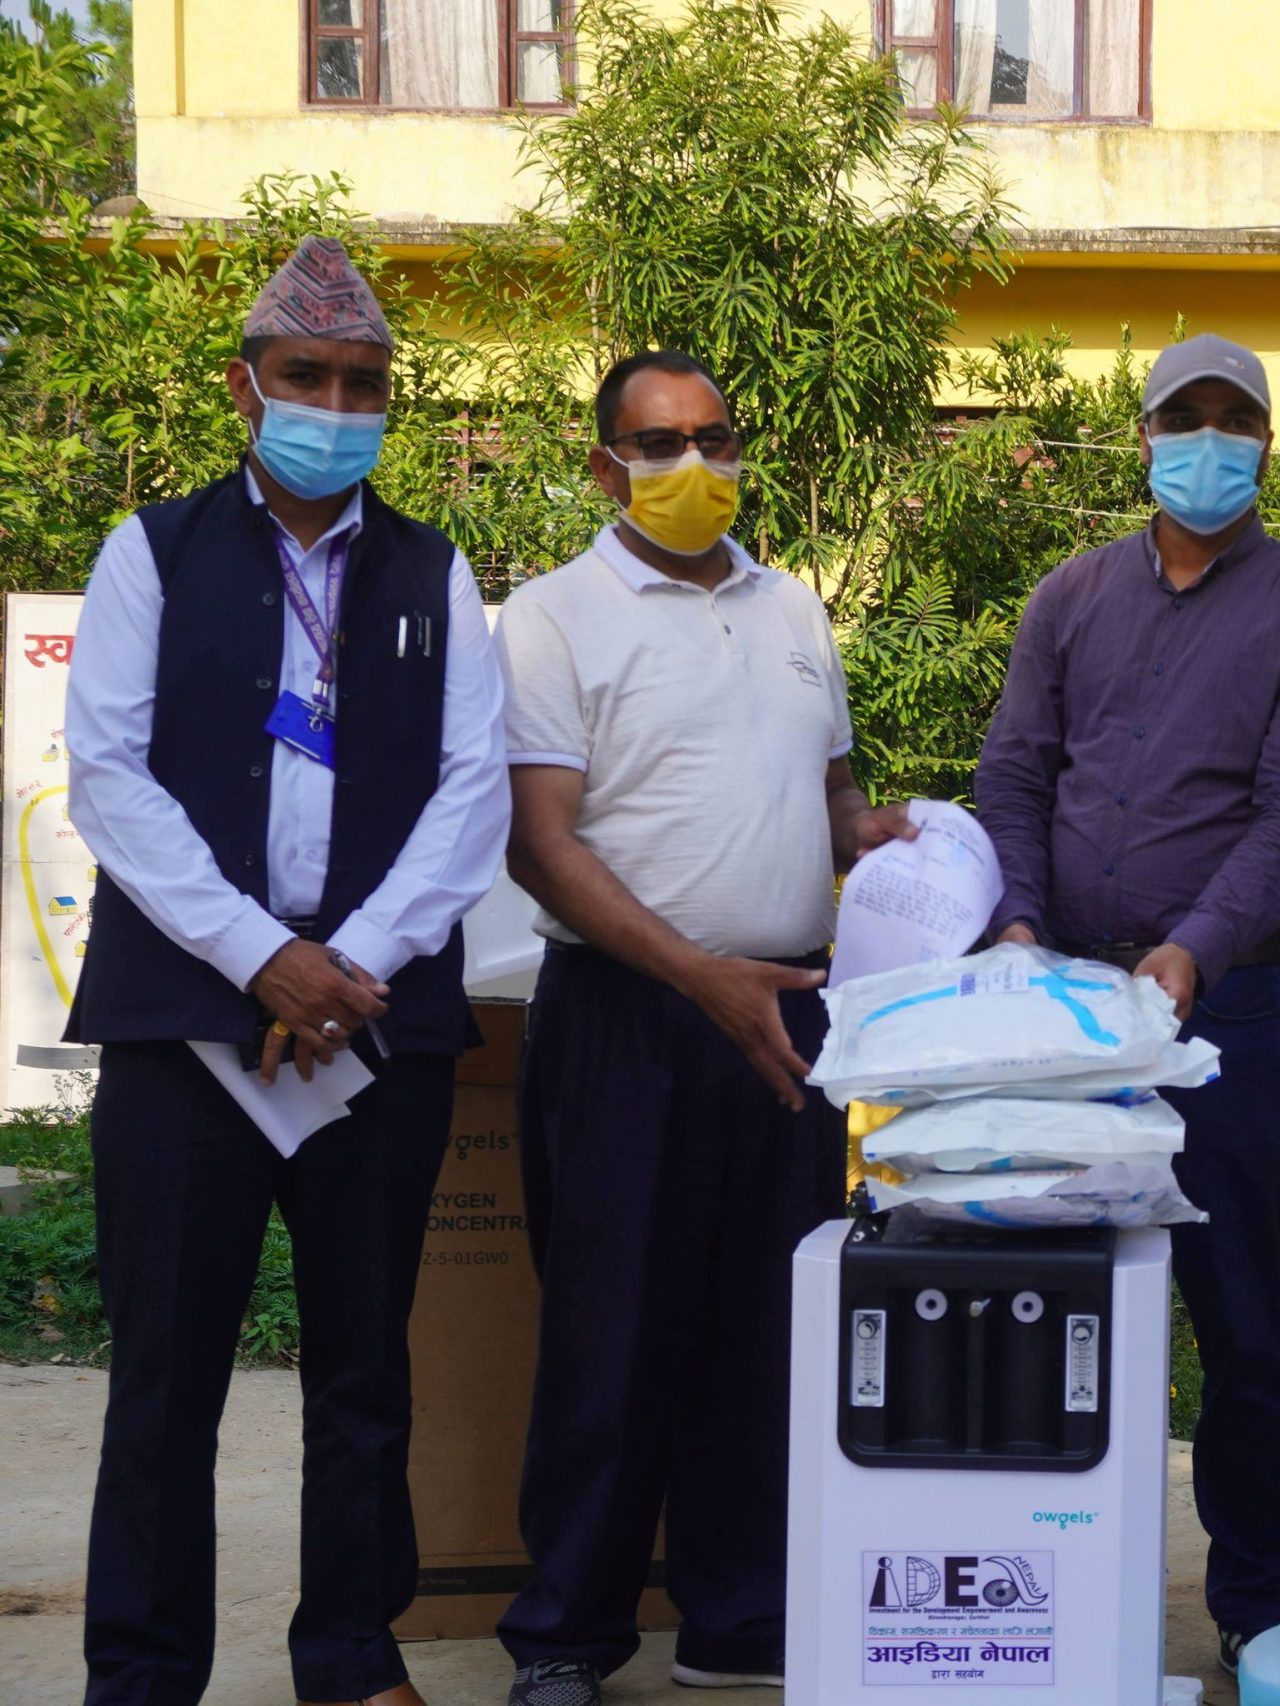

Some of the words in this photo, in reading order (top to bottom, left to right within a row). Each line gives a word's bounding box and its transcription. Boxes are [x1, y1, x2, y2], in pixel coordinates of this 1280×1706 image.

[432, 1193, 496, 1209] XYGEN
[869, 1607, 901, 1615] Investment
[923, 1607, 960, 1615] Development
[962, 1607, 1004, 1615] Empowerment
[951, 1628, 957, 1636] र
[867, 1641, 972, 1665] आइडिया
[979, 1641, 1052, 1664] नेपाल
[955, 1667, 985, 1680] सहयोग
